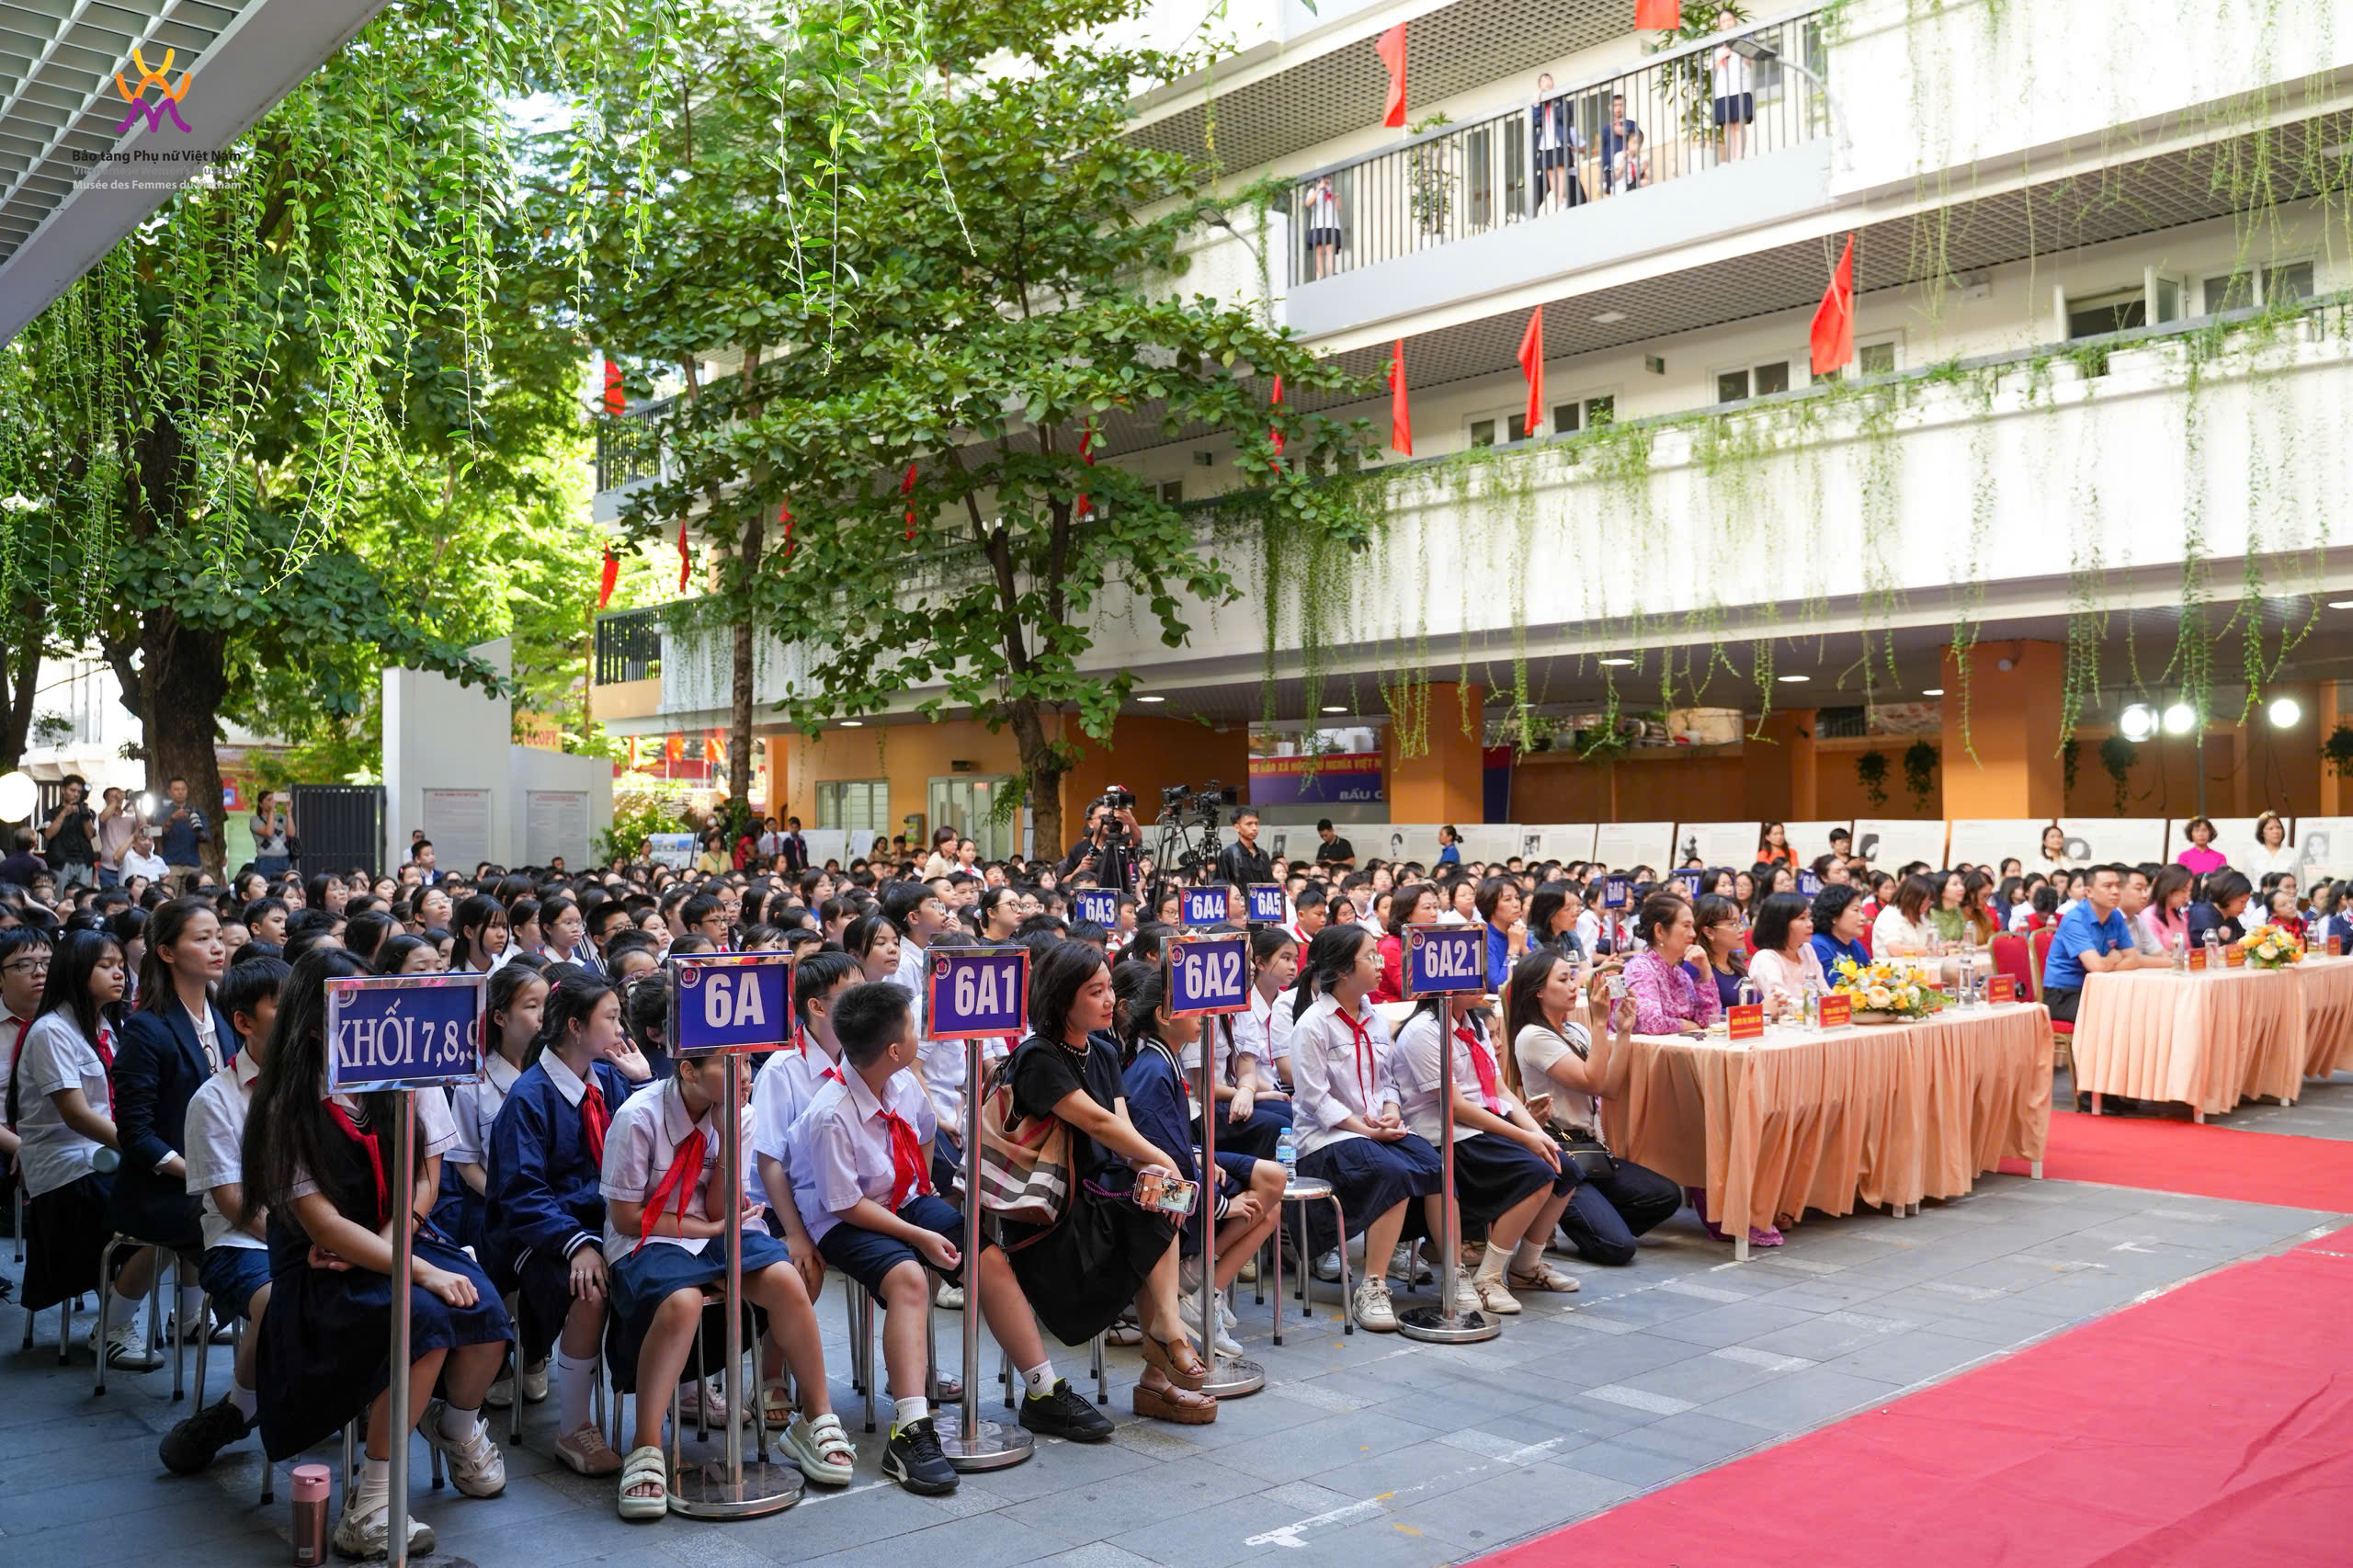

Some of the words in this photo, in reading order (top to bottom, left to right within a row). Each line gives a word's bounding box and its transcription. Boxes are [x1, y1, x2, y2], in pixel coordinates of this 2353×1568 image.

[1608, 881, 1625, 901] 6A6
[1680, 875, 1699, 894] A7
[1086, 897, 1115, 923] 6A3
[1192, 894, 1225, 919] 6A4
[1257, 892, 1281, 915] 6A5
[1425, 939, 1481, 978] 6A2.1
[954, 965, 1015, 1017] 6A1
[1185, 951, 1241, 1000] 6A2
[705, 971, 766, 1028] 6A
[338, 998, 415, 1067] KHỐI
